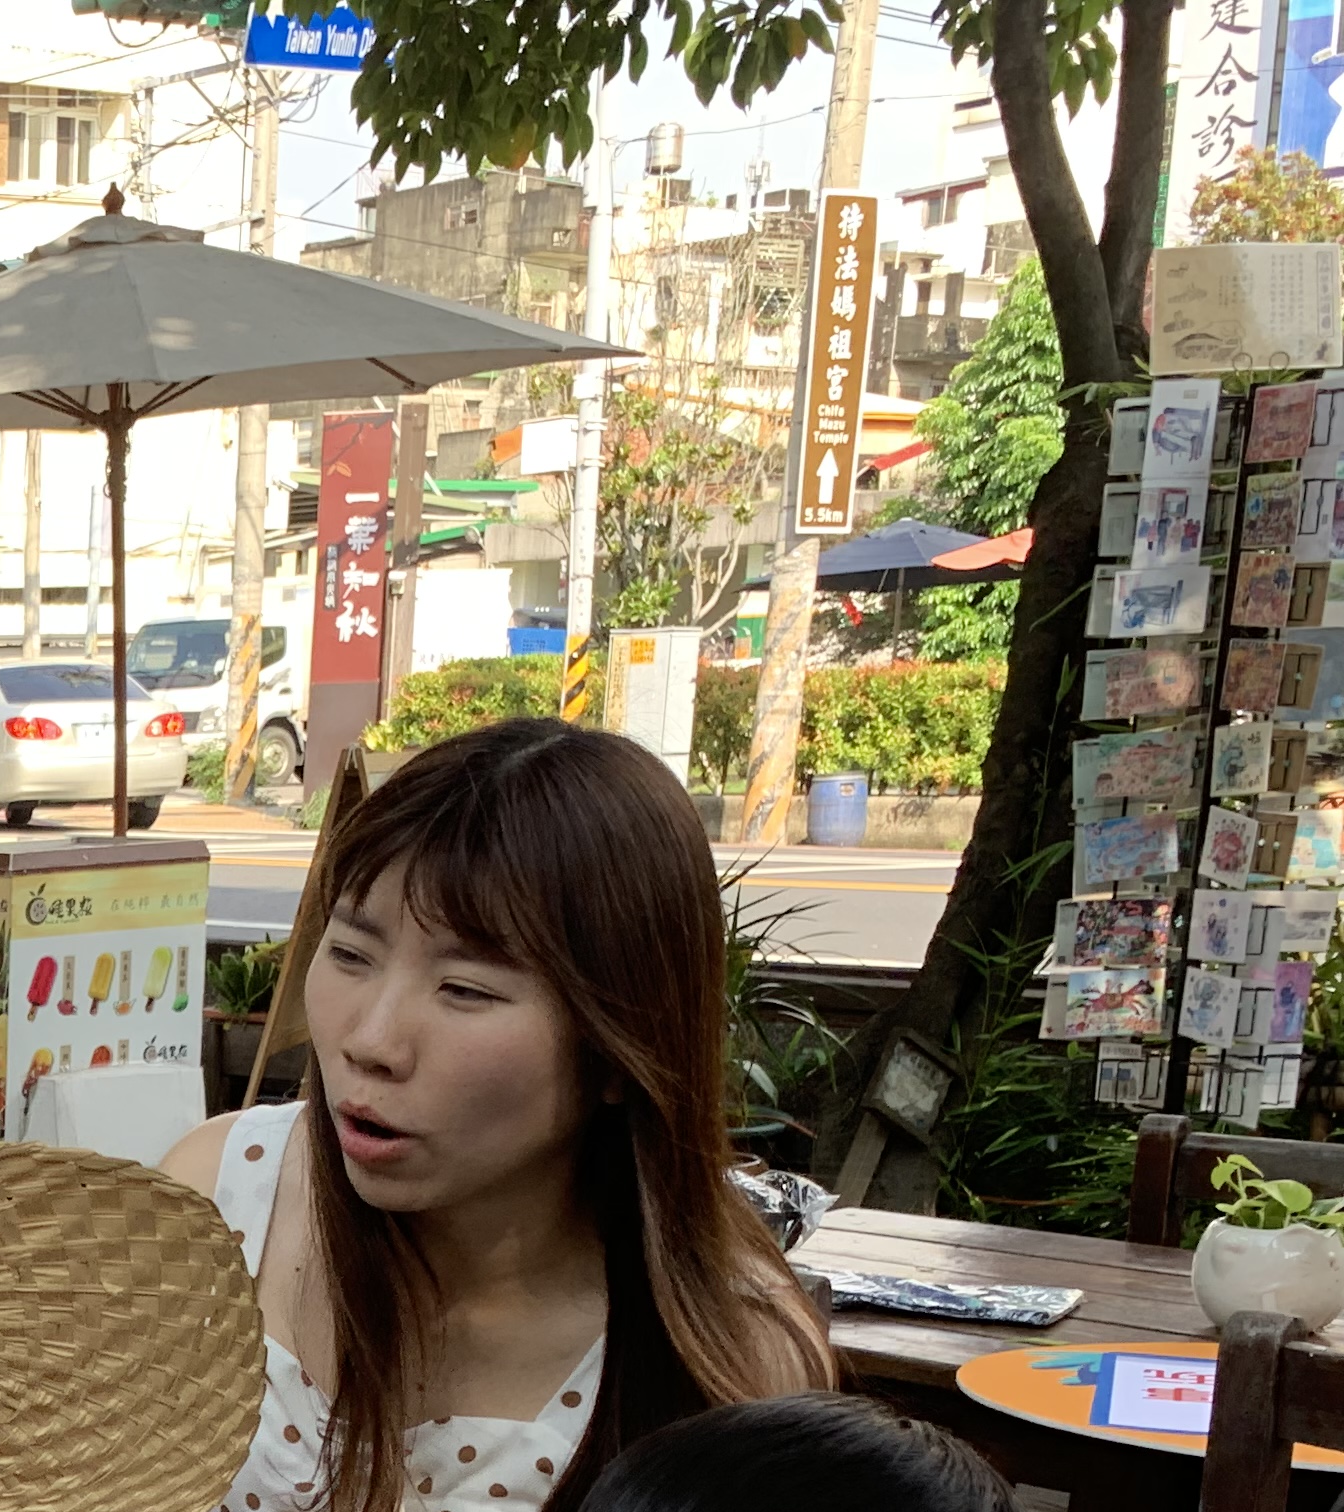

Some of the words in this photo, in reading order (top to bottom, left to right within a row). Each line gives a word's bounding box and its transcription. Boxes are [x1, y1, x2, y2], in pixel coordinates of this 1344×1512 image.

[285, 21, 322, 55] Taiwan
[325, 24, 357, 57] Yunlin
[1192, 0, 1261, 181] 建合診
[826, 202, 864, 400] 持法媽祖宮
[813, 431, 849, 446] Temple
[804, 507, 843, 523] 5.5km
[335, 492, 380, 643] 一葉知秋
